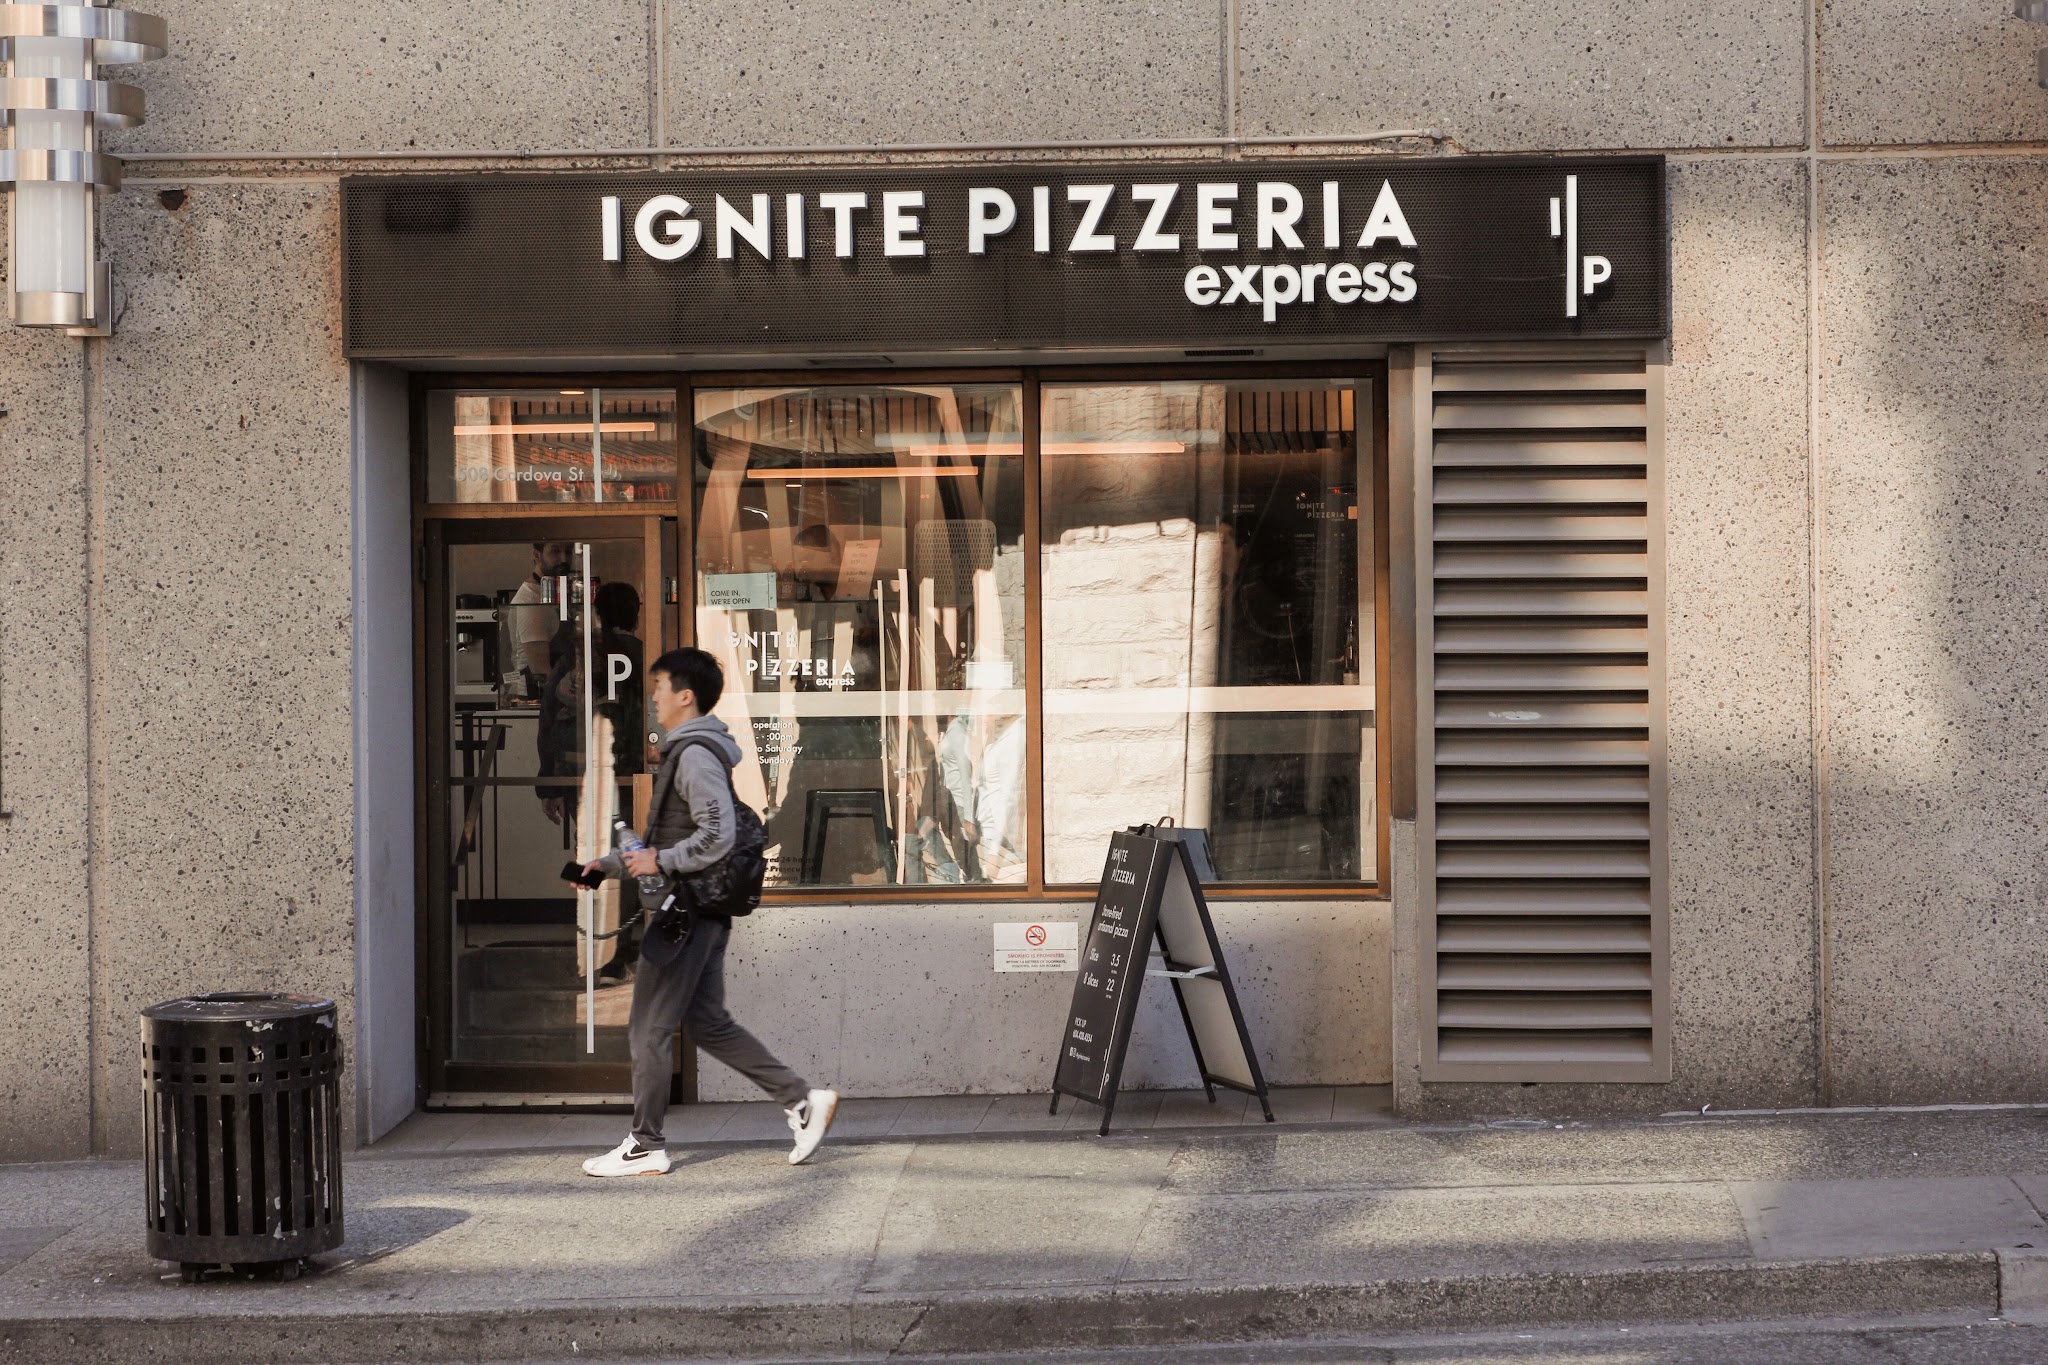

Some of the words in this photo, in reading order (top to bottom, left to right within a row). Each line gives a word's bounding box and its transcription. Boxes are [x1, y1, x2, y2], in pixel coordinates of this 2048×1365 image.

[601, 190, 926, 263] IGNITE
[968, 179, 1418, 254] PIZZERIA
[1184, 261, 1418, 323] express
[494, 466, 562, 482] Cordova
[568, 466, 584, 482] St
[1296, 502, 1325, 510] IGNITE
[1307, 511, 1345, 519] PIZZERIA
[732, 597, 751, 605] OPEN
[716, 631, 798, 649] GNITE
[745, 658, 856, 676] PIZZERIA
[815, 677, 856, 688] express
[753, 720, 793, 731] operation
[765, 744, 803, 754] Saturday
[759, 756, 794, 765] Sundays
[1111, 848, 1129, 862] IGNITE
[1111, 868, 1136, 885] PIZZERIA
[1113, 923, 1129, 938] pizza
[1106, 978, 1115, 992] 22
